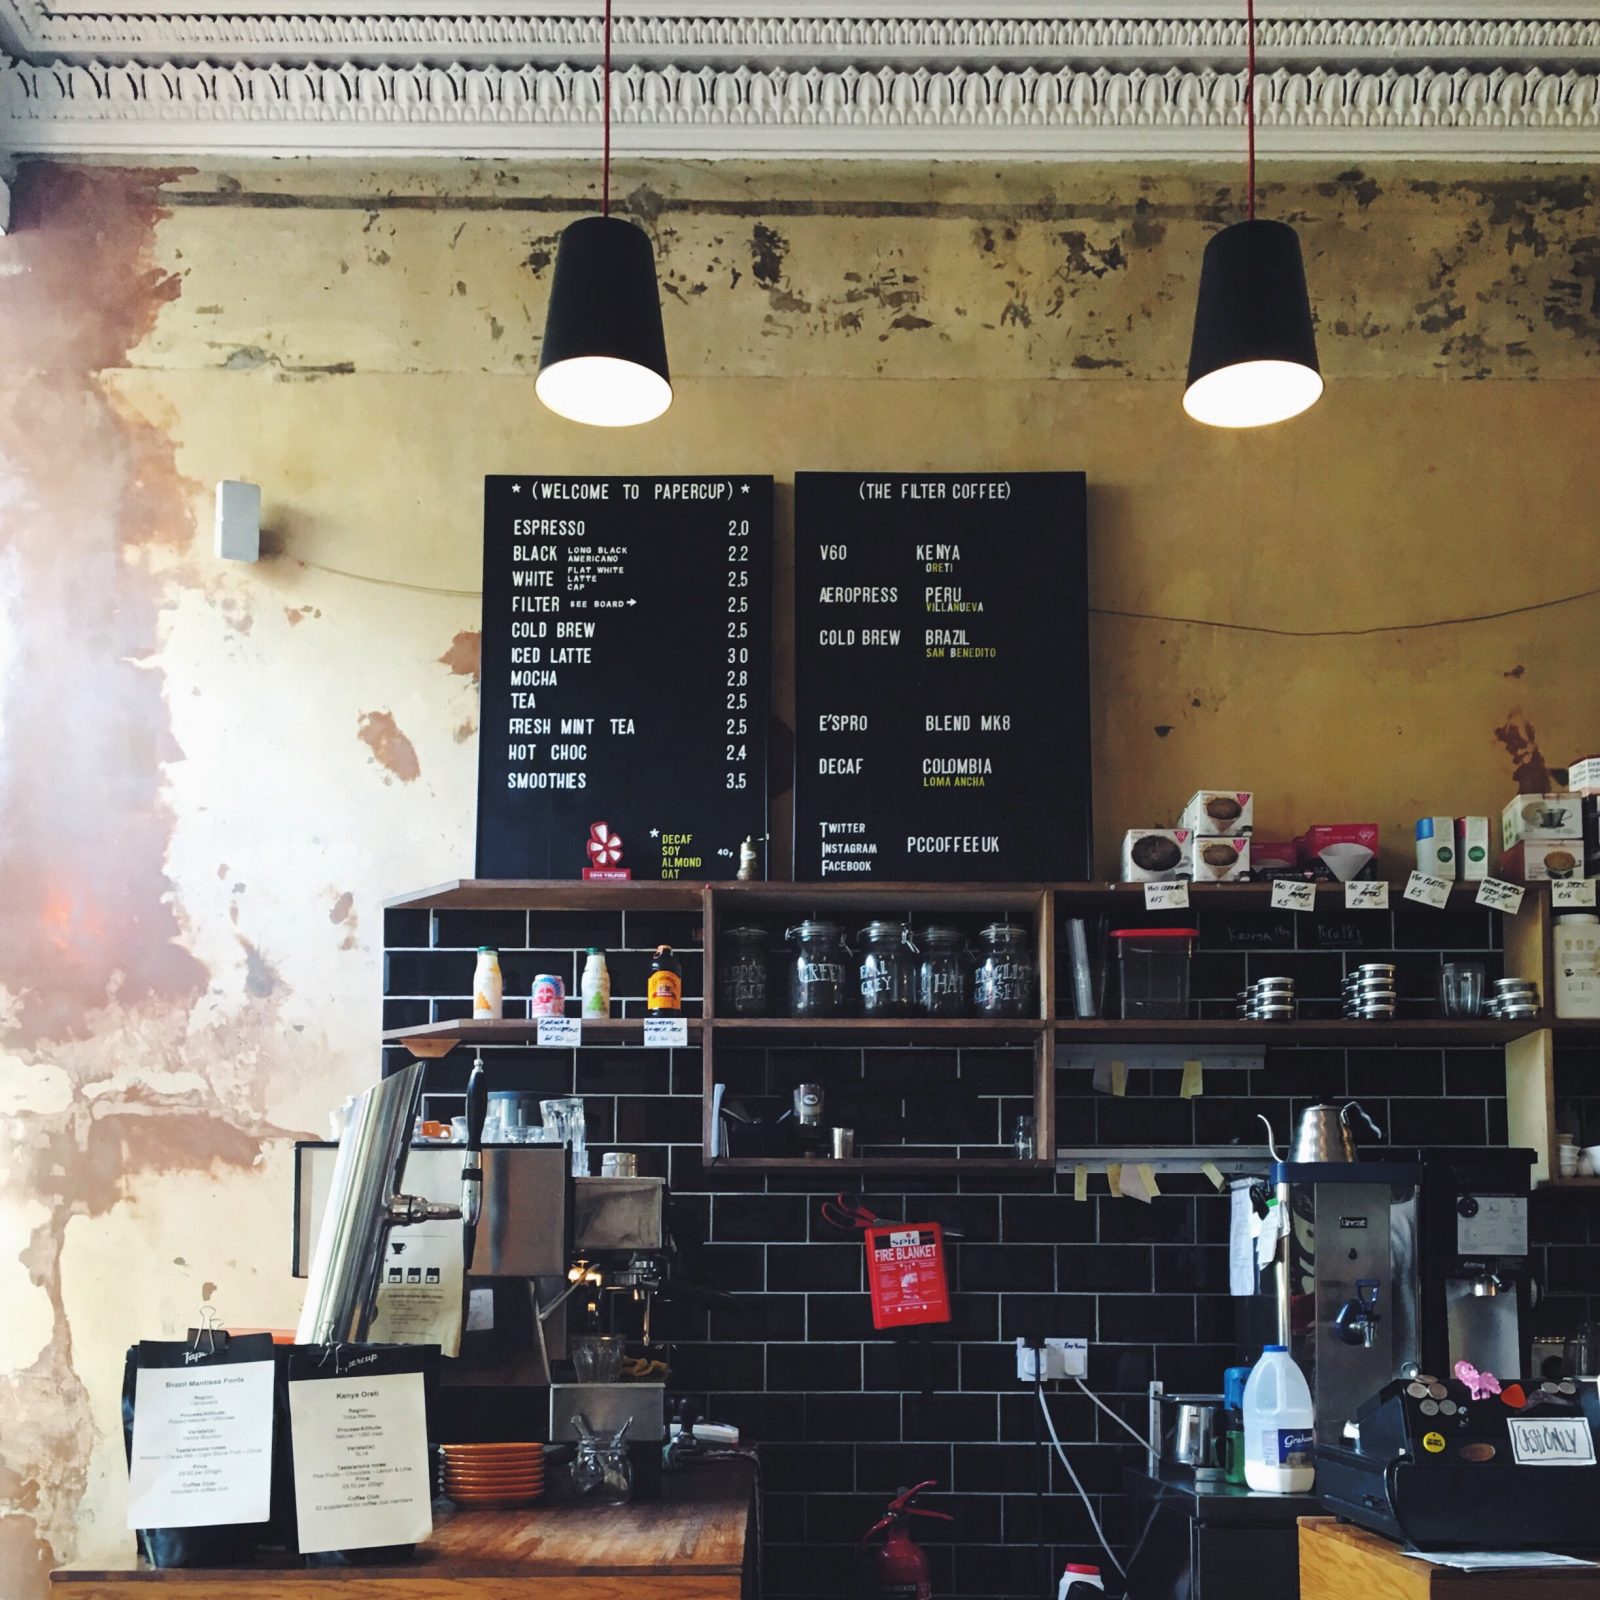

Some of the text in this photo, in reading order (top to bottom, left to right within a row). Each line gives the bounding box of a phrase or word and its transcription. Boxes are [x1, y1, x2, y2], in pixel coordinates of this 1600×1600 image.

[533, 481, 733, 500] (WELCOME TO PAPERCUP)
[860, 481, 1010, 500] (THE FILTER COFFEE)
[514, 519, 585, 536] ESPRESSO
[514, 545, 557, 561] BLACK
[567, 555, 619, 563] AMERICANO
[820, 545, 846, 560] V60
[917, 544, 960, 560] KENYA
[926, 563, 953, 573] ORETI
[512, 571, 554, 586] WHITE
[728, 571, 748, 587] 2.5
[925, 586, 962, 602] PERU
[512, 596, 559, 612] FILTER
[728, 597, 748, 612] 2.5
[926, 602, 984, 612] VILLANUEVA
[512, 622, 595, 638] COLD BREW
[728, 622, 747, 638] 2.5
[820, 630, 900, 645] COLD BREW
[926, 630, 969, 645] BRAZIL
[511, 647, 591, 663] ICED LATTE
[926, 647, 996, 658] SAN BENEDITO
[511, 670, 557, 686] MOCHA
[727, 671, 747, 687] 2.8
[511, 693, 536, 709] TEA
[727, 693, 747, 709] 2.5
[509, 718, 635, 735] FRESH MINT TEA
[727, 719, 747, 735] 2.5
[926, 715, 1010, 731] BLEND MK8
[508, 744, 587, 760] HOT CHOC
[727, 745, 746, 761] 2.4
[819, 758, 863, 774] DECAF
[923, 758, 992, 774] COLOMBIA
[508, 772, 586, 789] SMOOTHIES
[726, 773, 746, 789] 3.5
[923, 777, 985, 787] LOMA ANCHA
[662, 834, 693, 845] DECAF
[908, 836, 999, 852] PCCOFFEEUK
[662, 846, 680, 856] SOY
[662, 857, 702, 868] ALMOND
[662, 869, 679, 879] OAT
[875, 1244, 936, 1262] FIRE BLANKET
[165, 1381, 187, 1389] Brazil
[336, 1390, 379, 1400] Kenya Oreti
[1517, 1425, 1576, 1454] CASH ONLY
